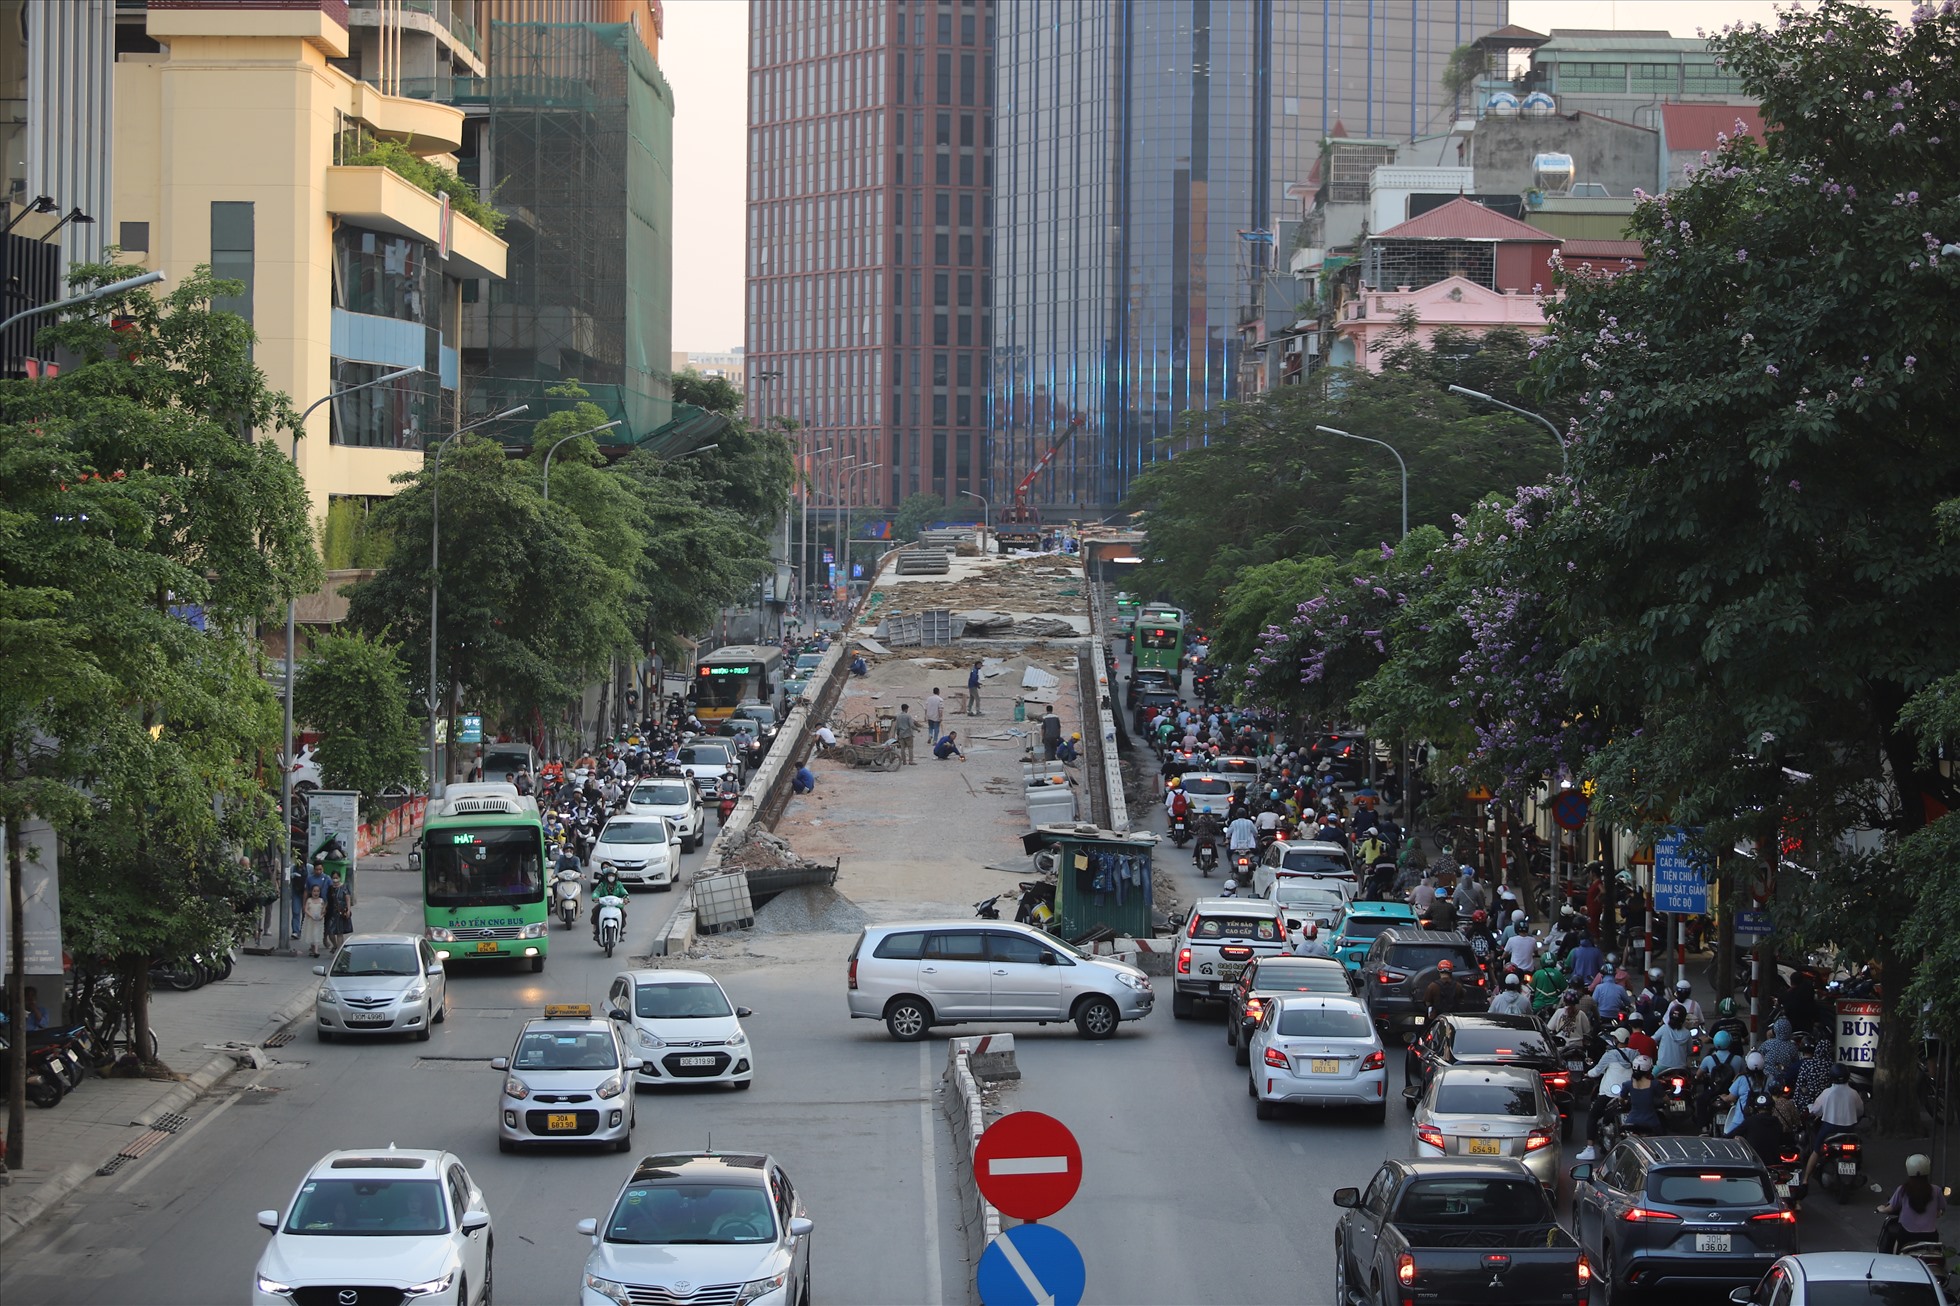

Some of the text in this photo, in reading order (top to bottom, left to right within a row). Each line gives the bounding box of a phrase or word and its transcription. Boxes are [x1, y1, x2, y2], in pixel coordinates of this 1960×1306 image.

[1660, 855, 1673, 867] CÁC
[1662, 869, 1677, 882] TIỆN
[1655, 883, 1672, 893] QUAN
[1688, 883, 1706, 896] GIẢM
[1668, 894, 1692, 910] TỐC ĐỘ
[468, 916, 486, 926] YẾN
[488, 918, 505, 926] CNG
[507, 917, 524, 925] BUS
[1842, 1003, 1864, 1012] Lan
[1842, 1017, 1880, 1036] BÚN
[1706, 1235, 1722, 1243] 30H
[1701, 1243, 1728, 1251] 136.02
